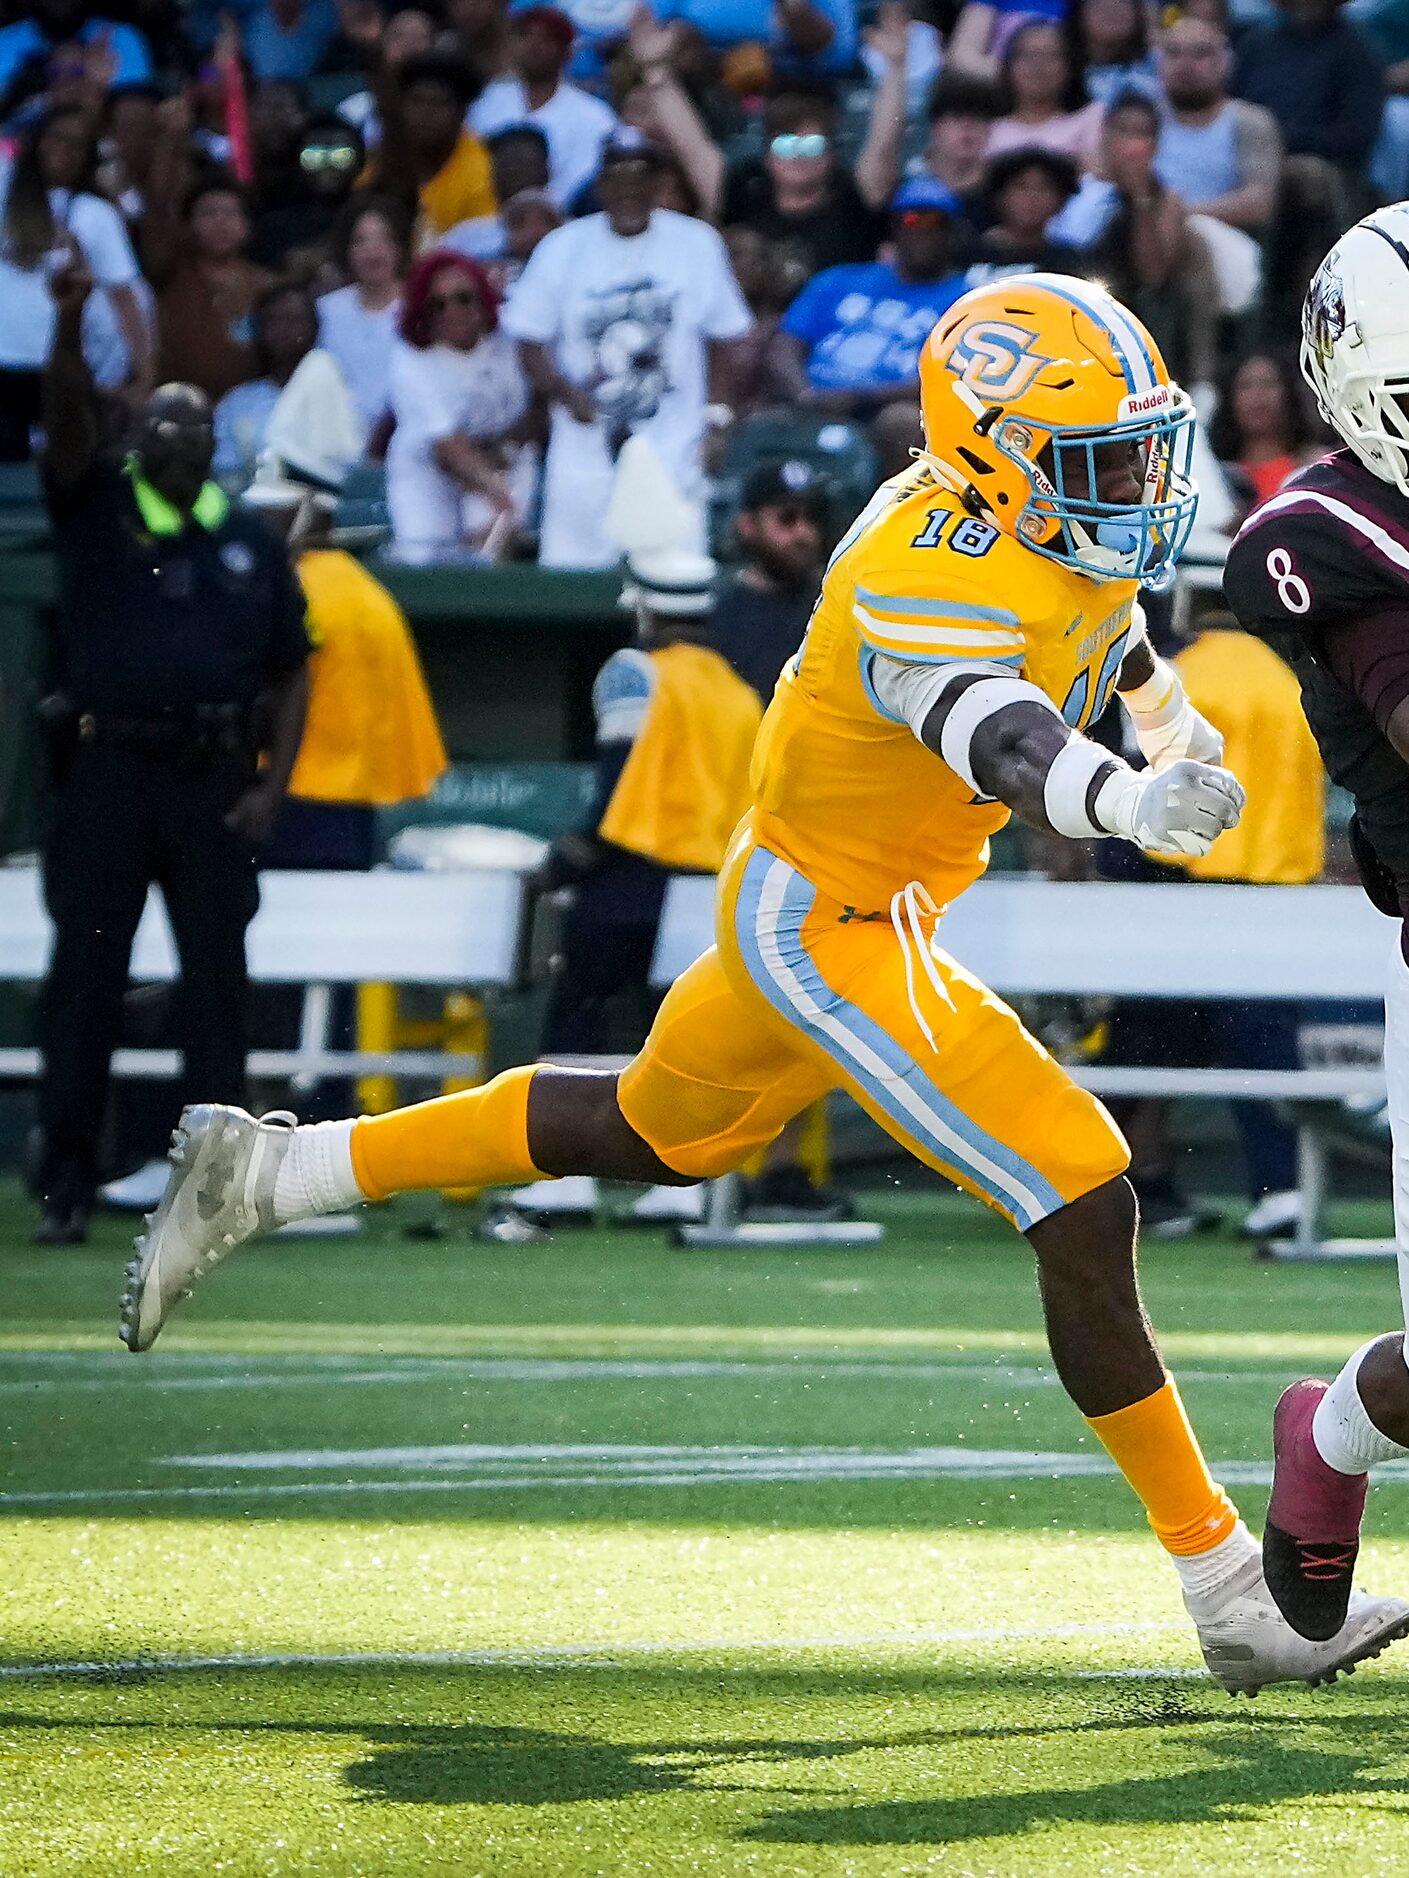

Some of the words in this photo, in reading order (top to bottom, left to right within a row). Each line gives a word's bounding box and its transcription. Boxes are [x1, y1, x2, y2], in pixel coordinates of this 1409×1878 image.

[1128, 390, 1169, 414] Riddell
[1032, 469, 1054, 496] Ridd
[909, 508, 1002, 558] 18
[1266, 547, 1311, 614] 8
